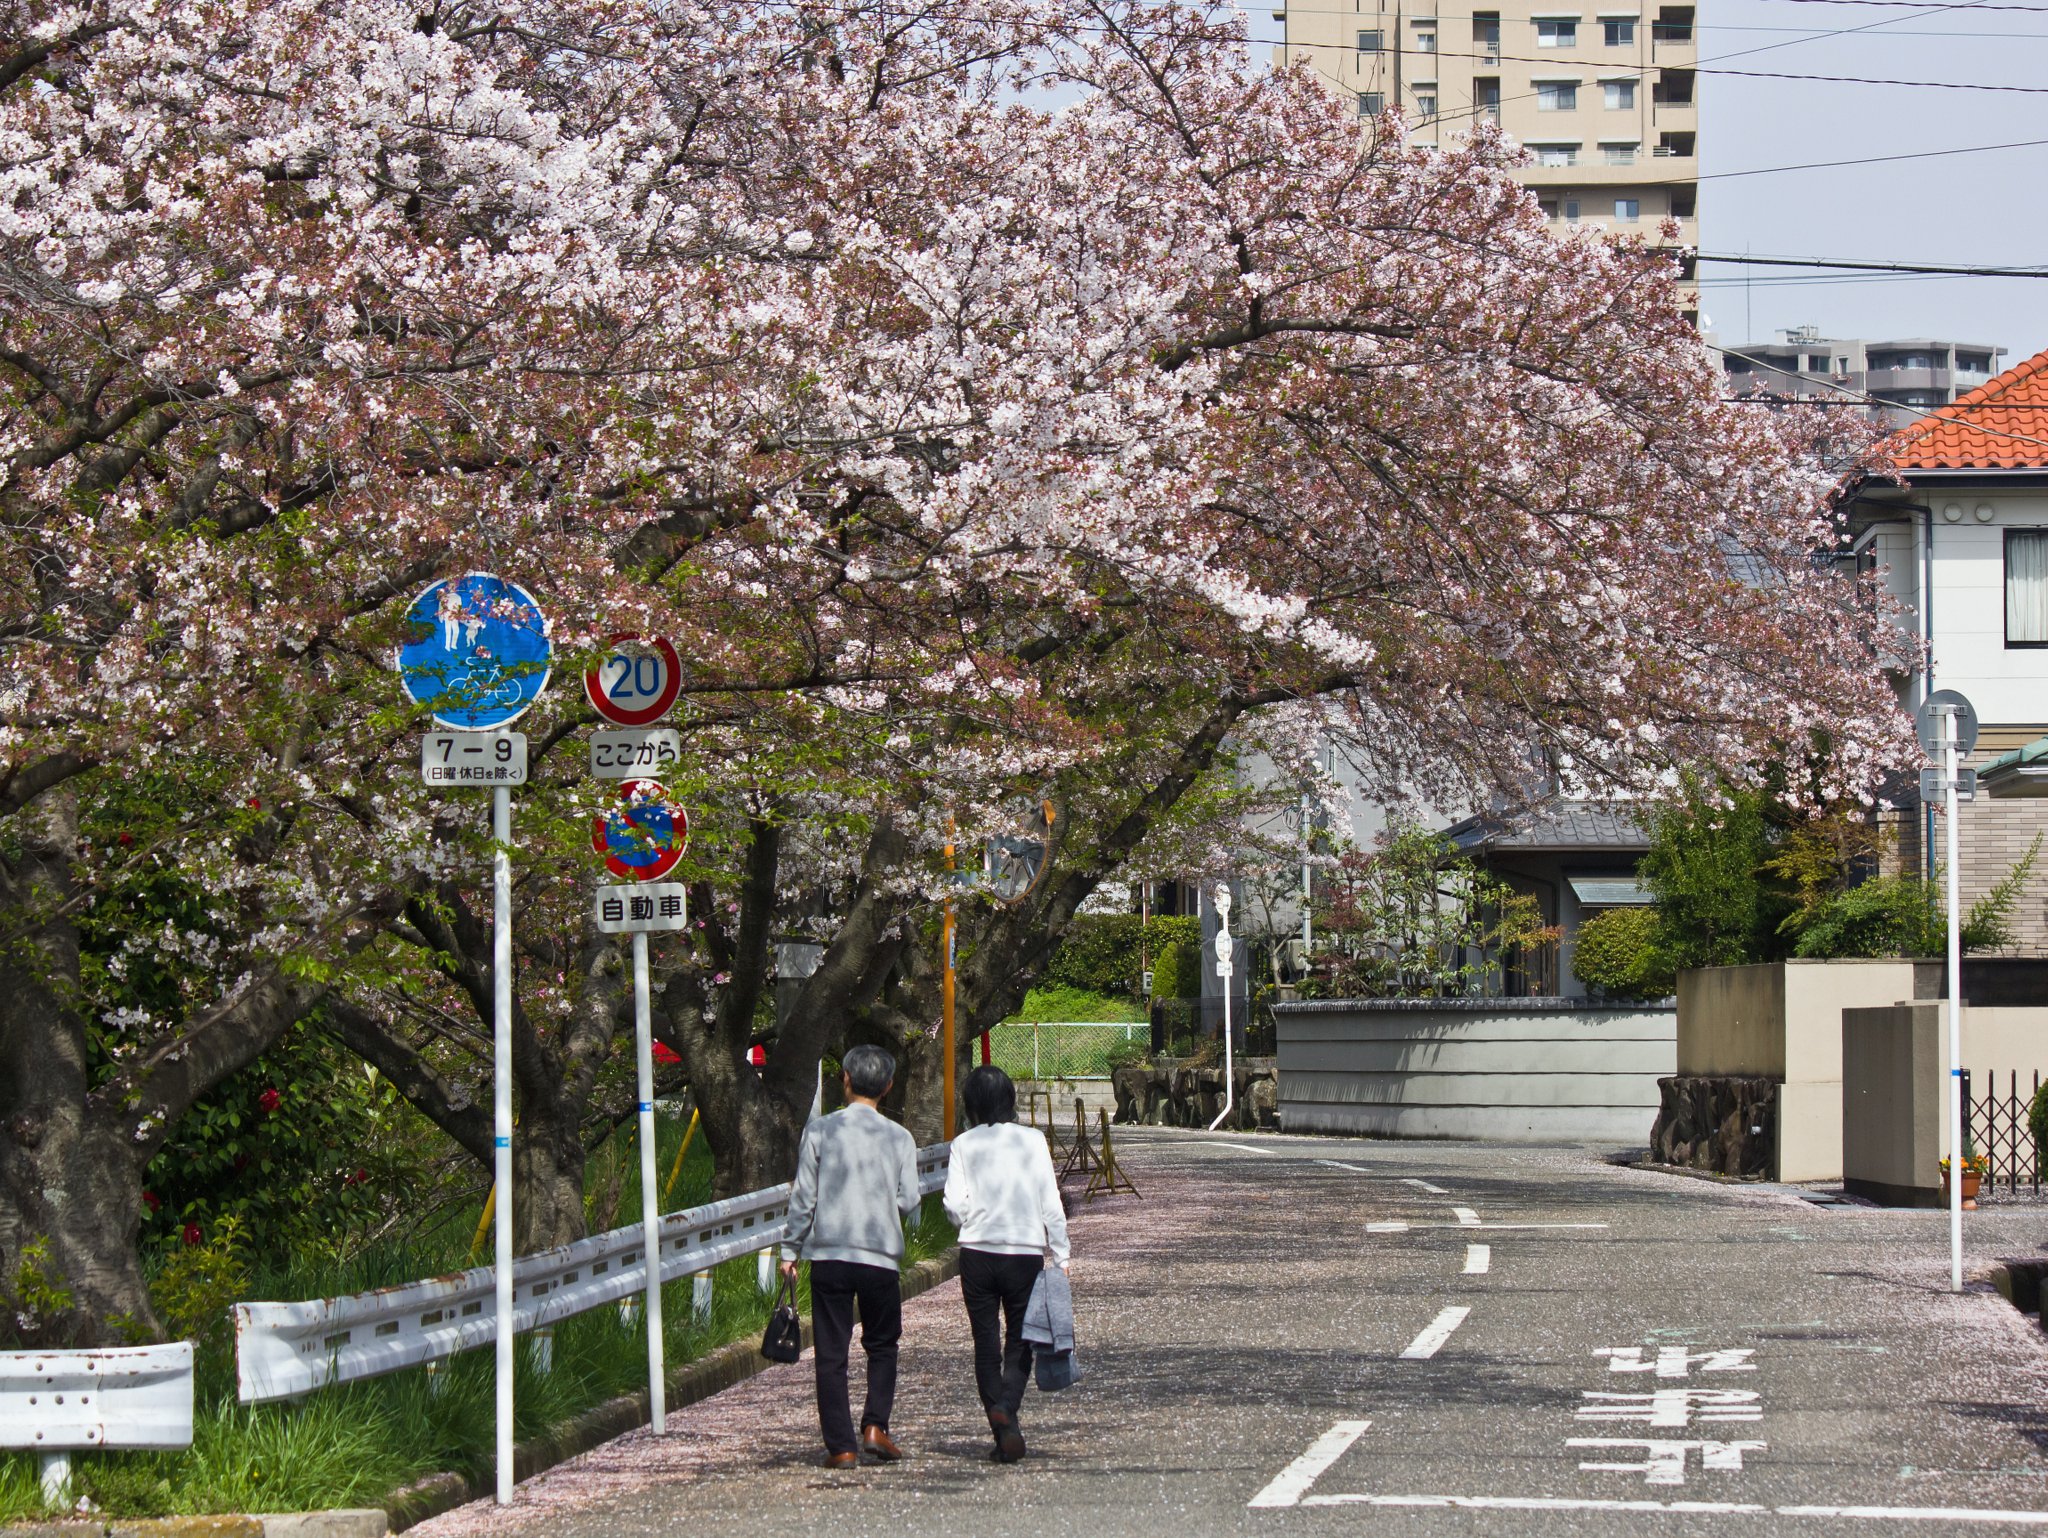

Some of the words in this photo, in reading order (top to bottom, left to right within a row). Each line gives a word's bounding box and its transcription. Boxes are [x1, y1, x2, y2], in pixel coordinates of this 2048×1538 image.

[607, 655, 660, 698] 20
[596, 741, 676, 767] ここから
[602, 894, 682, 921] 自動車
